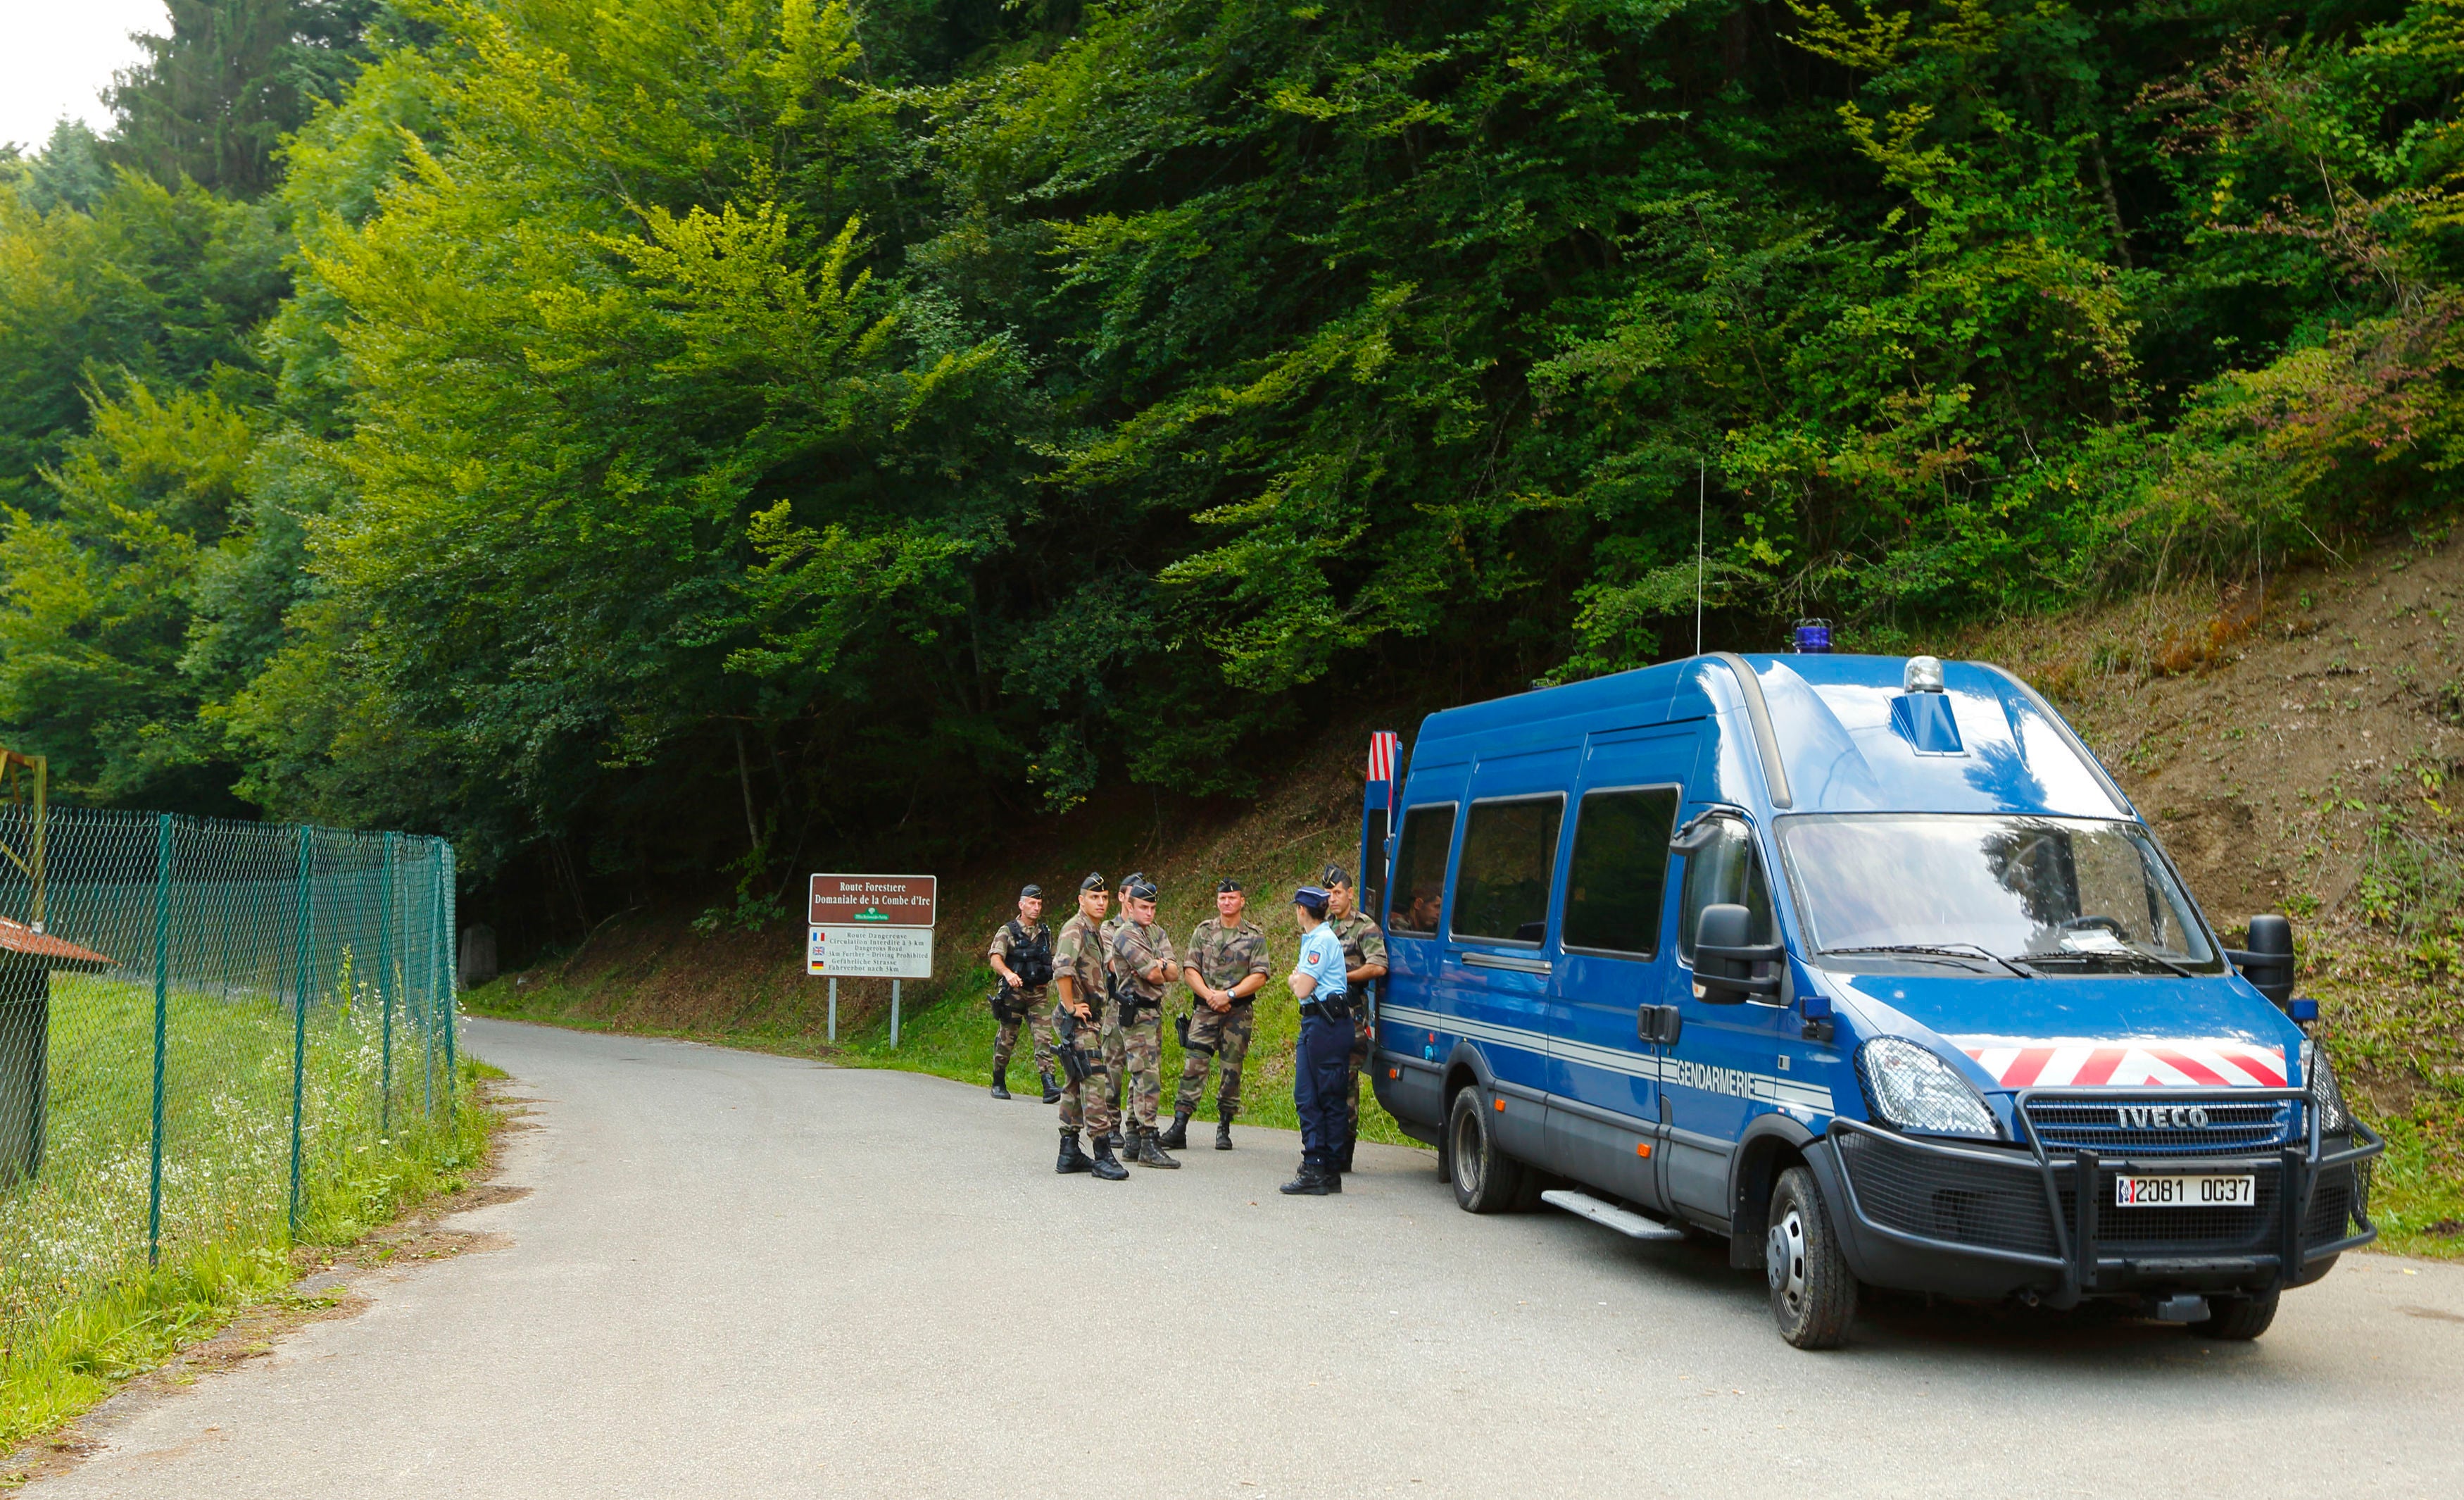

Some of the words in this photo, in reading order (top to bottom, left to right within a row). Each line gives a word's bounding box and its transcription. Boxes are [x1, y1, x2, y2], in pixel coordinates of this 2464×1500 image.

[840, 882, 863, 892] Route
[815, 894, 857, 904] Domaniale
[860, 895, 869, 904] de
[872, 895, 879, 905] la
[881, 895, 909, 905] Combe
[911, 896, 931, 906] d'Ire
[1677, 1059, 1756, 1100] GENDARMERIE
[2117, 1106, 2209, 1129] IVECO
[2136, 1179, 2184, 1202] 2081
[2201, 1179, 2251, 1202] 0037
